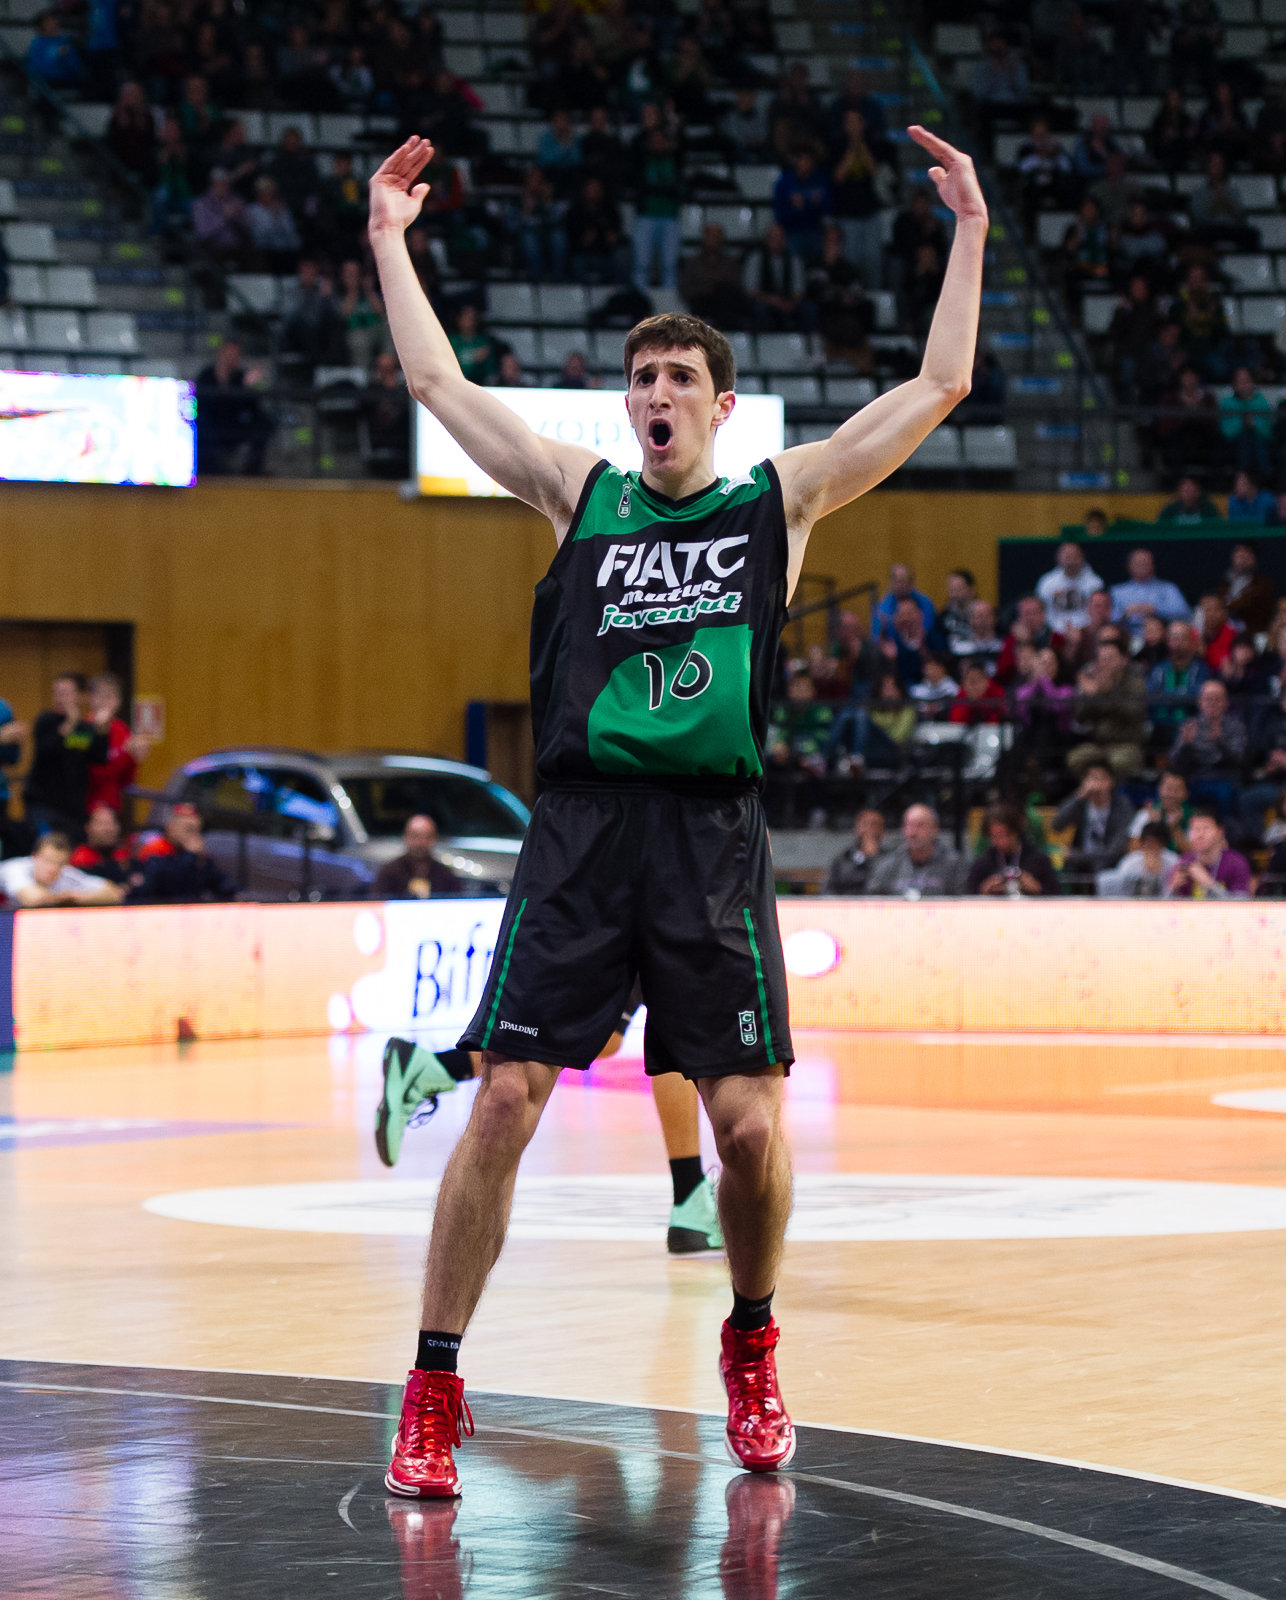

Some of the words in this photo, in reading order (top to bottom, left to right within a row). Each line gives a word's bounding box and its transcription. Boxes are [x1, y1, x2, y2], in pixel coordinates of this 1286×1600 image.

[596, 534, 749, 588] FIATC
[619, 579, 722, 606] mutua
[643, 650, 713, 711] 10
[499, 1020, 539, 1037] SPALDING
